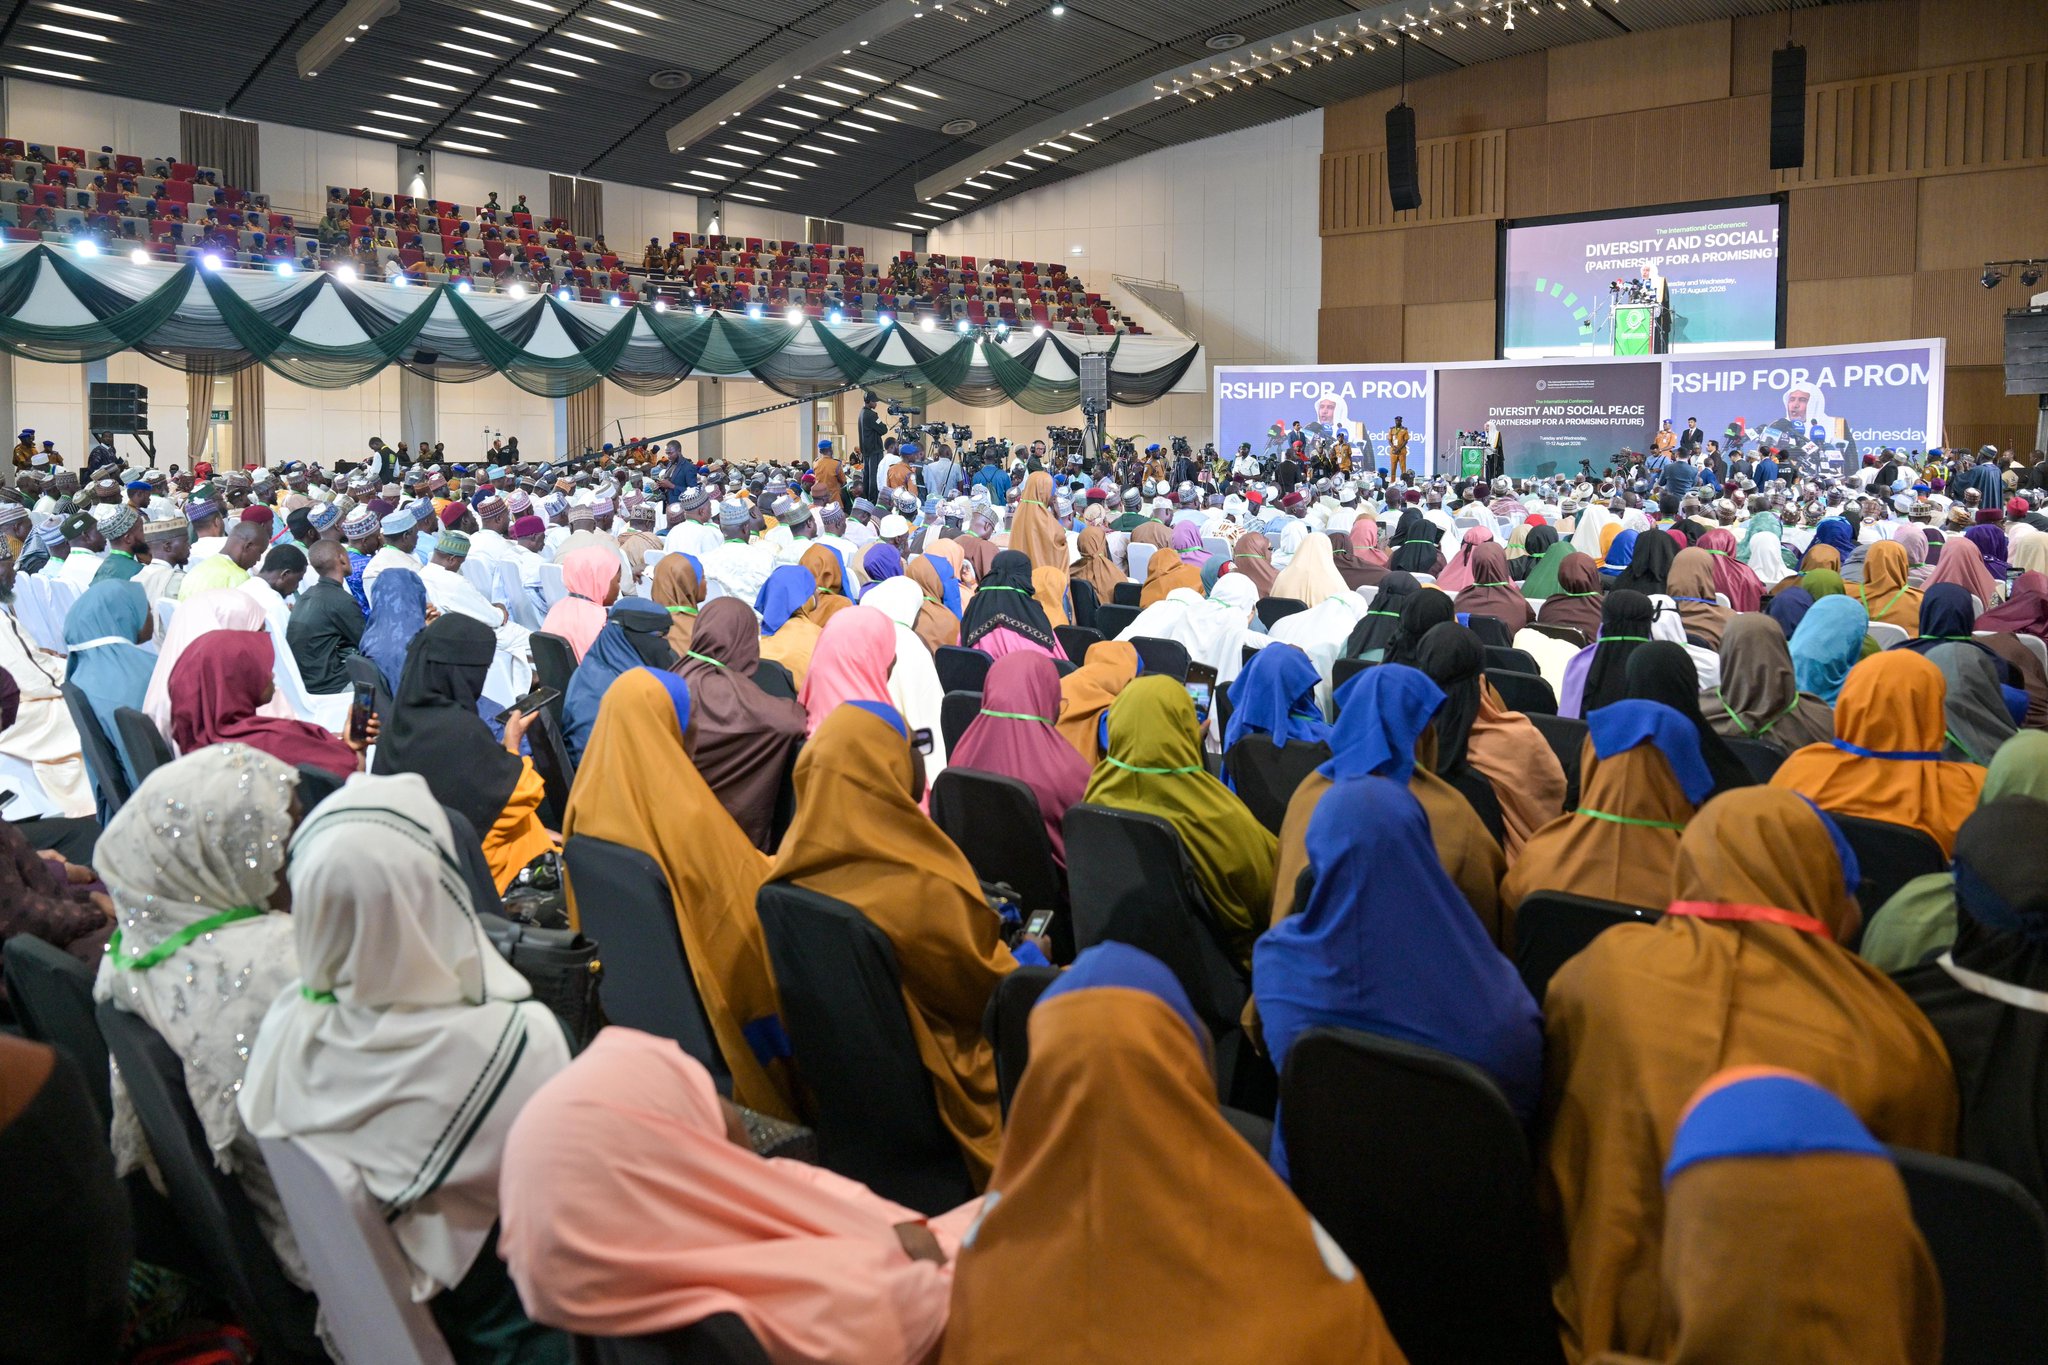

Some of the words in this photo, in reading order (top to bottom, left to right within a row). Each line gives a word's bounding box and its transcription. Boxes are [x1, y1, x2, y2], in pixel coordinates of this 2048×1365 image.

[1668, 224, 1707, 234] International
[1707, 221, 1748, 230] Conference:
[1585, 238, 1664, 257] DIVERSITY
[1666, 235, 1701, 251] AND
[1704, 229, 1769, 248] SOCIAL
[1585, 256, 1664, 273] (PARTNERSHIP
[1666, 254, 1690, 265] FOR
[1691, 253, 1700, 264] A
[1702, 247, 1773, 263] PROMISING
[1699, 277, 1737, 285] Wednesday,
[1687, 286, 1708, 294] August
[1671, 370, 1747, 393] RSHIP
[1752, 368, 1810, 391] FOR
[1816, 366, 1837, 388] A
[1844, 362, 1930, 387] PROM
[1220, 382, 1285, 399] RSHIP
[1289, 381, 1336, 399] FOR
[1340, 381, 1357, 398] A
[1362, 380, 1427, 399] PROM
[1489, 406, 1540, 416] DIVERSITY
[1542, 406, 1565, 415] AND
[1566, 405, 1606, 415] SOCIAL
[1608, 405, 1645, 415] PEACE
[1542, 418, 1558, 426] FOR
[1565, 418, 1609, 426] PROMISING
[1610, 417, 1645, 427] FUTURE)
[1850, 427, 1927, 444] ednesday
